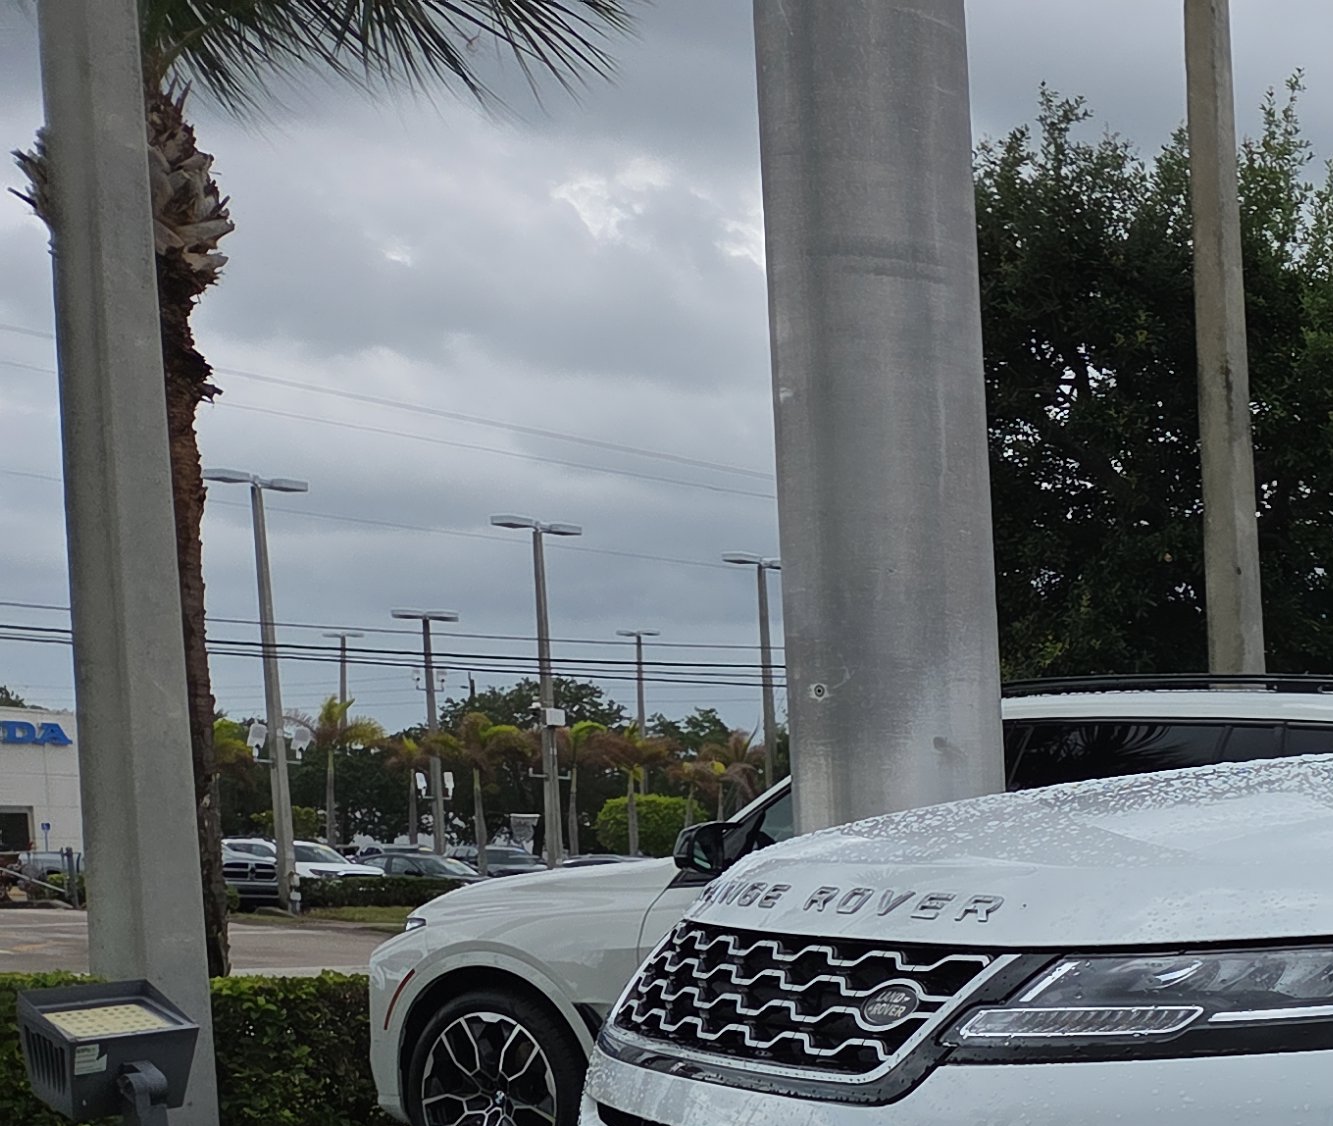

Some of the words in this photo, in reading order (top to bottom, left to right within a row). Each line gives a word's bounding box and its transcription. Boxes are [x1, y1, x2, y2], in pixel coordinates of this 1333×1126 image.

[701, 881, 792, 909] ANGE
[803, 886, 1005, 923] ROVER
[876, 991, 906, 1003] LAND
[870, 1002, 907, 1018] ROVER
